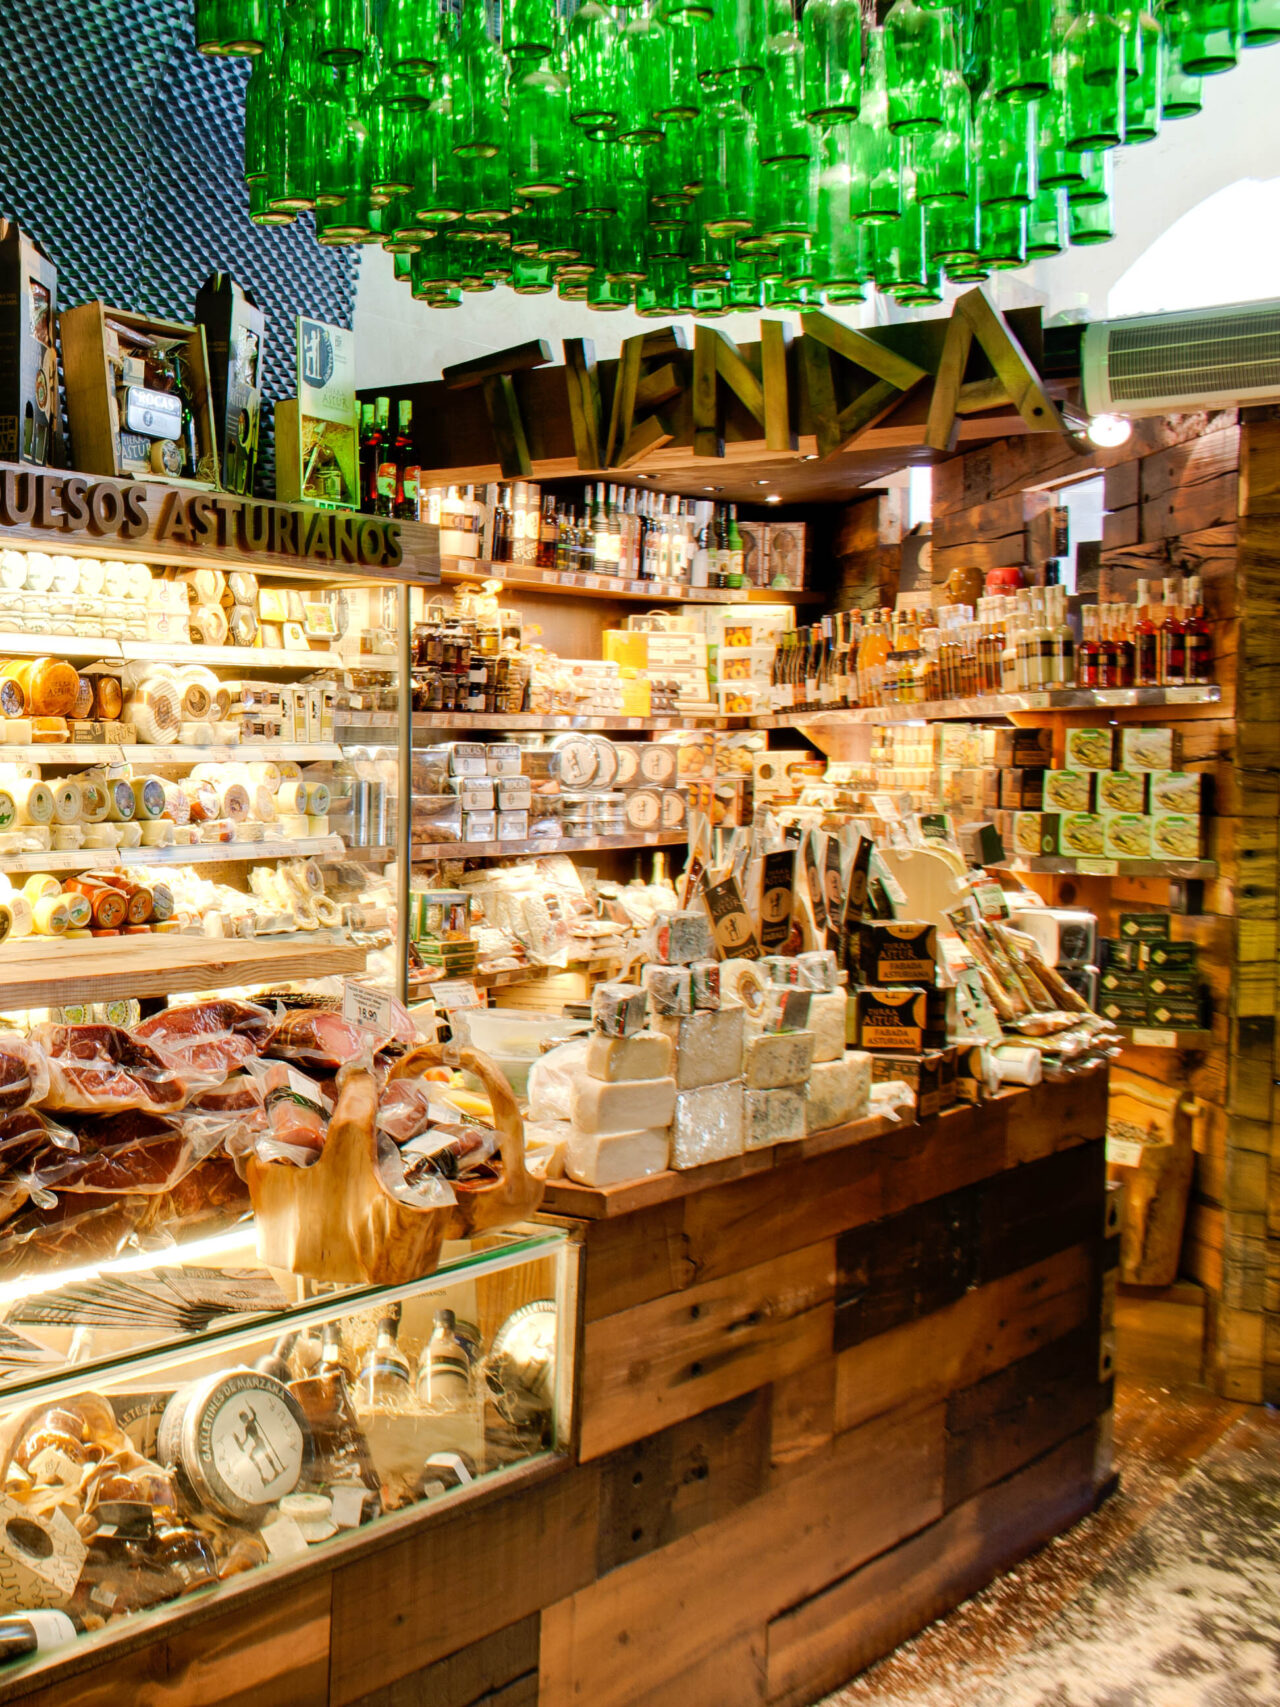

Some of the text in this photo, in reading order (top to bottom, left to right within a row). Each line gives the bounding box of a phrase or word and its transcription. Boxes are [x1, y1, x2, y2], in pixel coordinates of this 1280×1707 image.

[441, 286, 1066, 478] TIENDA
[154, 490, 403, 568] ASTURIANOS
[879, 950, 918, 961] ASTUR
[889, 961, 923, 970] FABADA
[862, 1015, 904, 1027] ASTUR
[874, 1028, 909, 1037] FABADA
[868, 1037, 916, 1046] ASTURIANA
[201, 1375, 286, 1462] GALLETINES DE MANZANA
